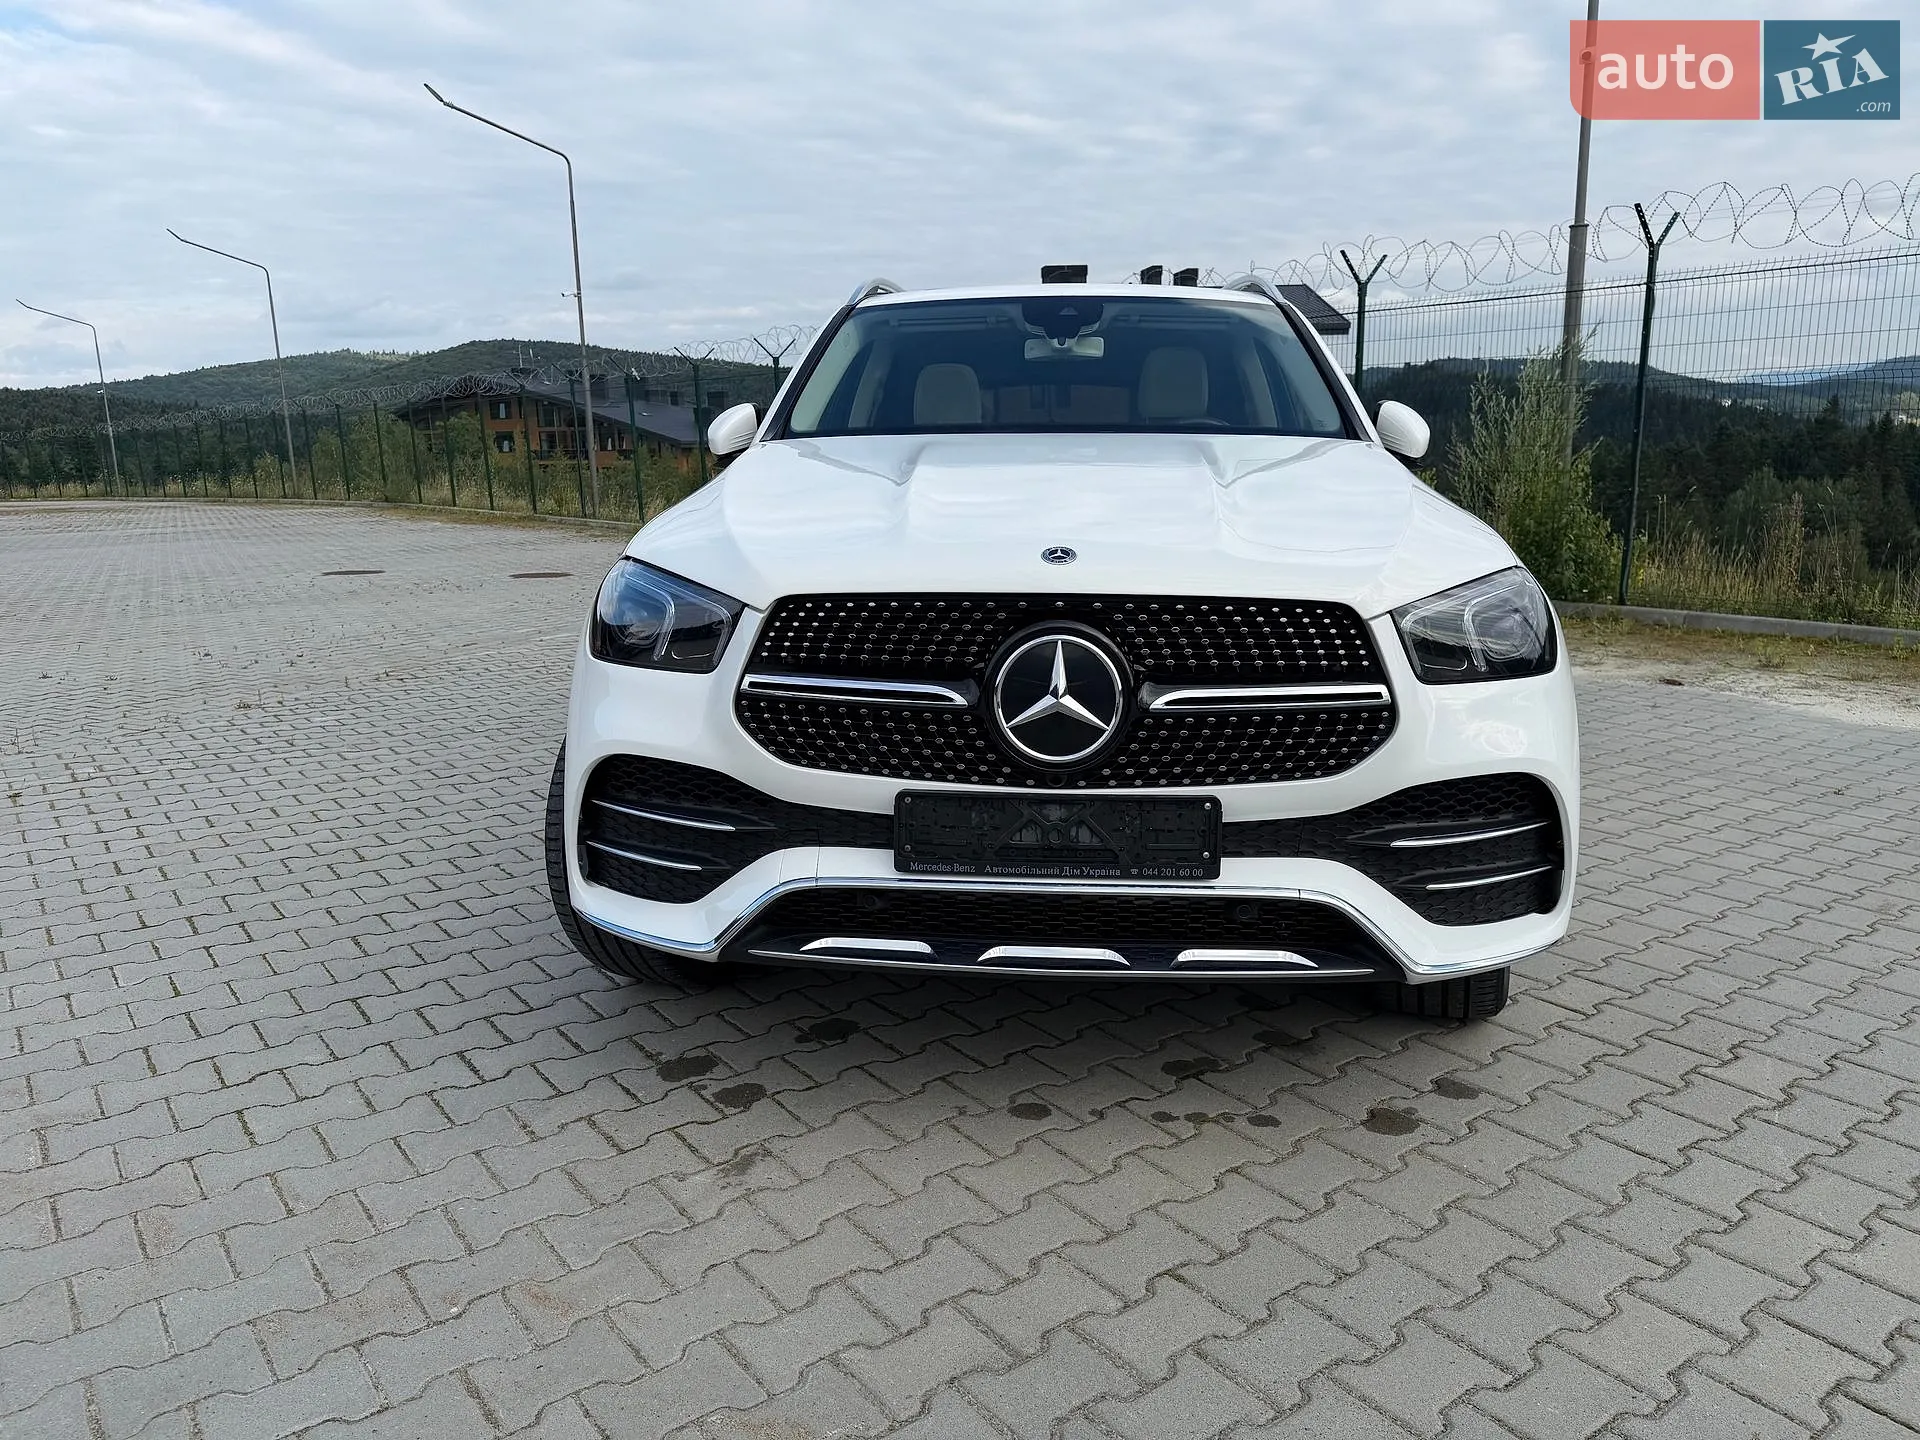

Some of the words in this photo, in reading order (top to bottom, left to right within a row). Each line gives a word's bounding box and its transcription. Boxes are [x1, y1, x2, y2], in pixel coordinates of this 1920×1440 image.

[984, 864, 1060, 875] Автомобільний
[1061, 866, 1081, 877] Дім
[1082, 866, 1121, 878] Україна
[1142, 867, 1158, 876] 044
[1160, 867, 1176, 877] 201
[1179, 867, 1191, 877] 60
[1192, 868, 1204, 877] 00
